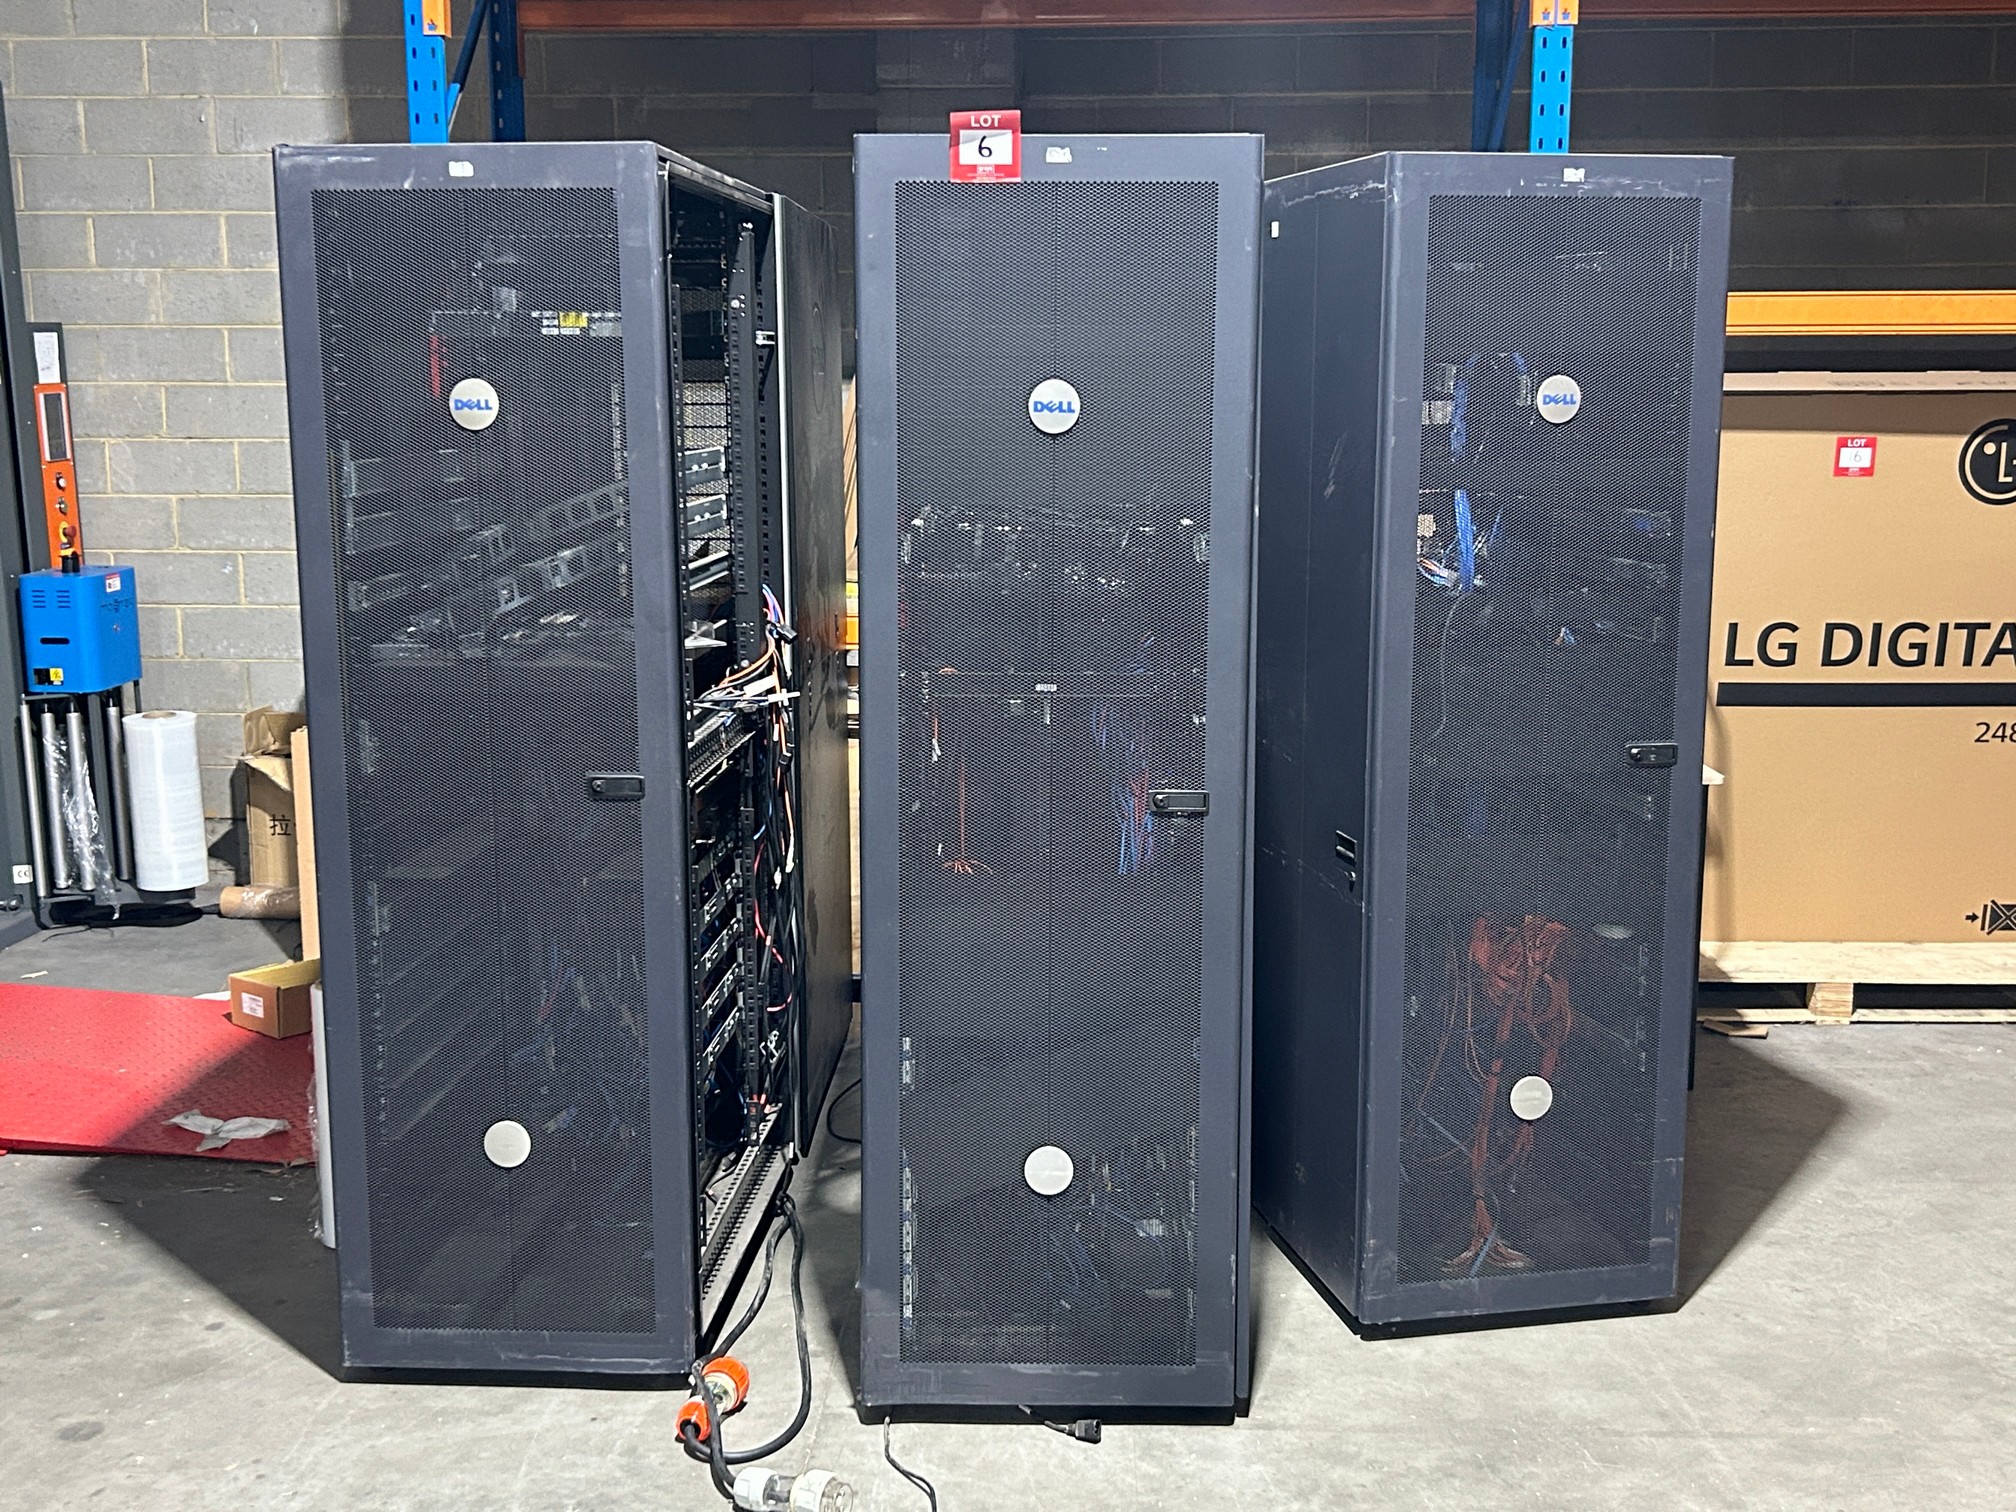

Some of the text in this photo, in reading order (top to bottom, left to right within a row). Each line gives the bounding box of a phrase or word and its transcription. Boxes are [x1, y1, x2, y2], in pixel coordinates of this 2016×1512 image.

[970, 114, 1002, 128] LOT
[978, 135, 993, 158] 6
[453, 398, 493, 411] DELL
[1542, 393, 1577, 405] DELL
[1033, 400, 1076, 414] DELL
[1847, 438, 1867, 447] LOT
[1724, 622, 2016, 667] LG DIGITA
[269, 814, 296, 836] 拉
